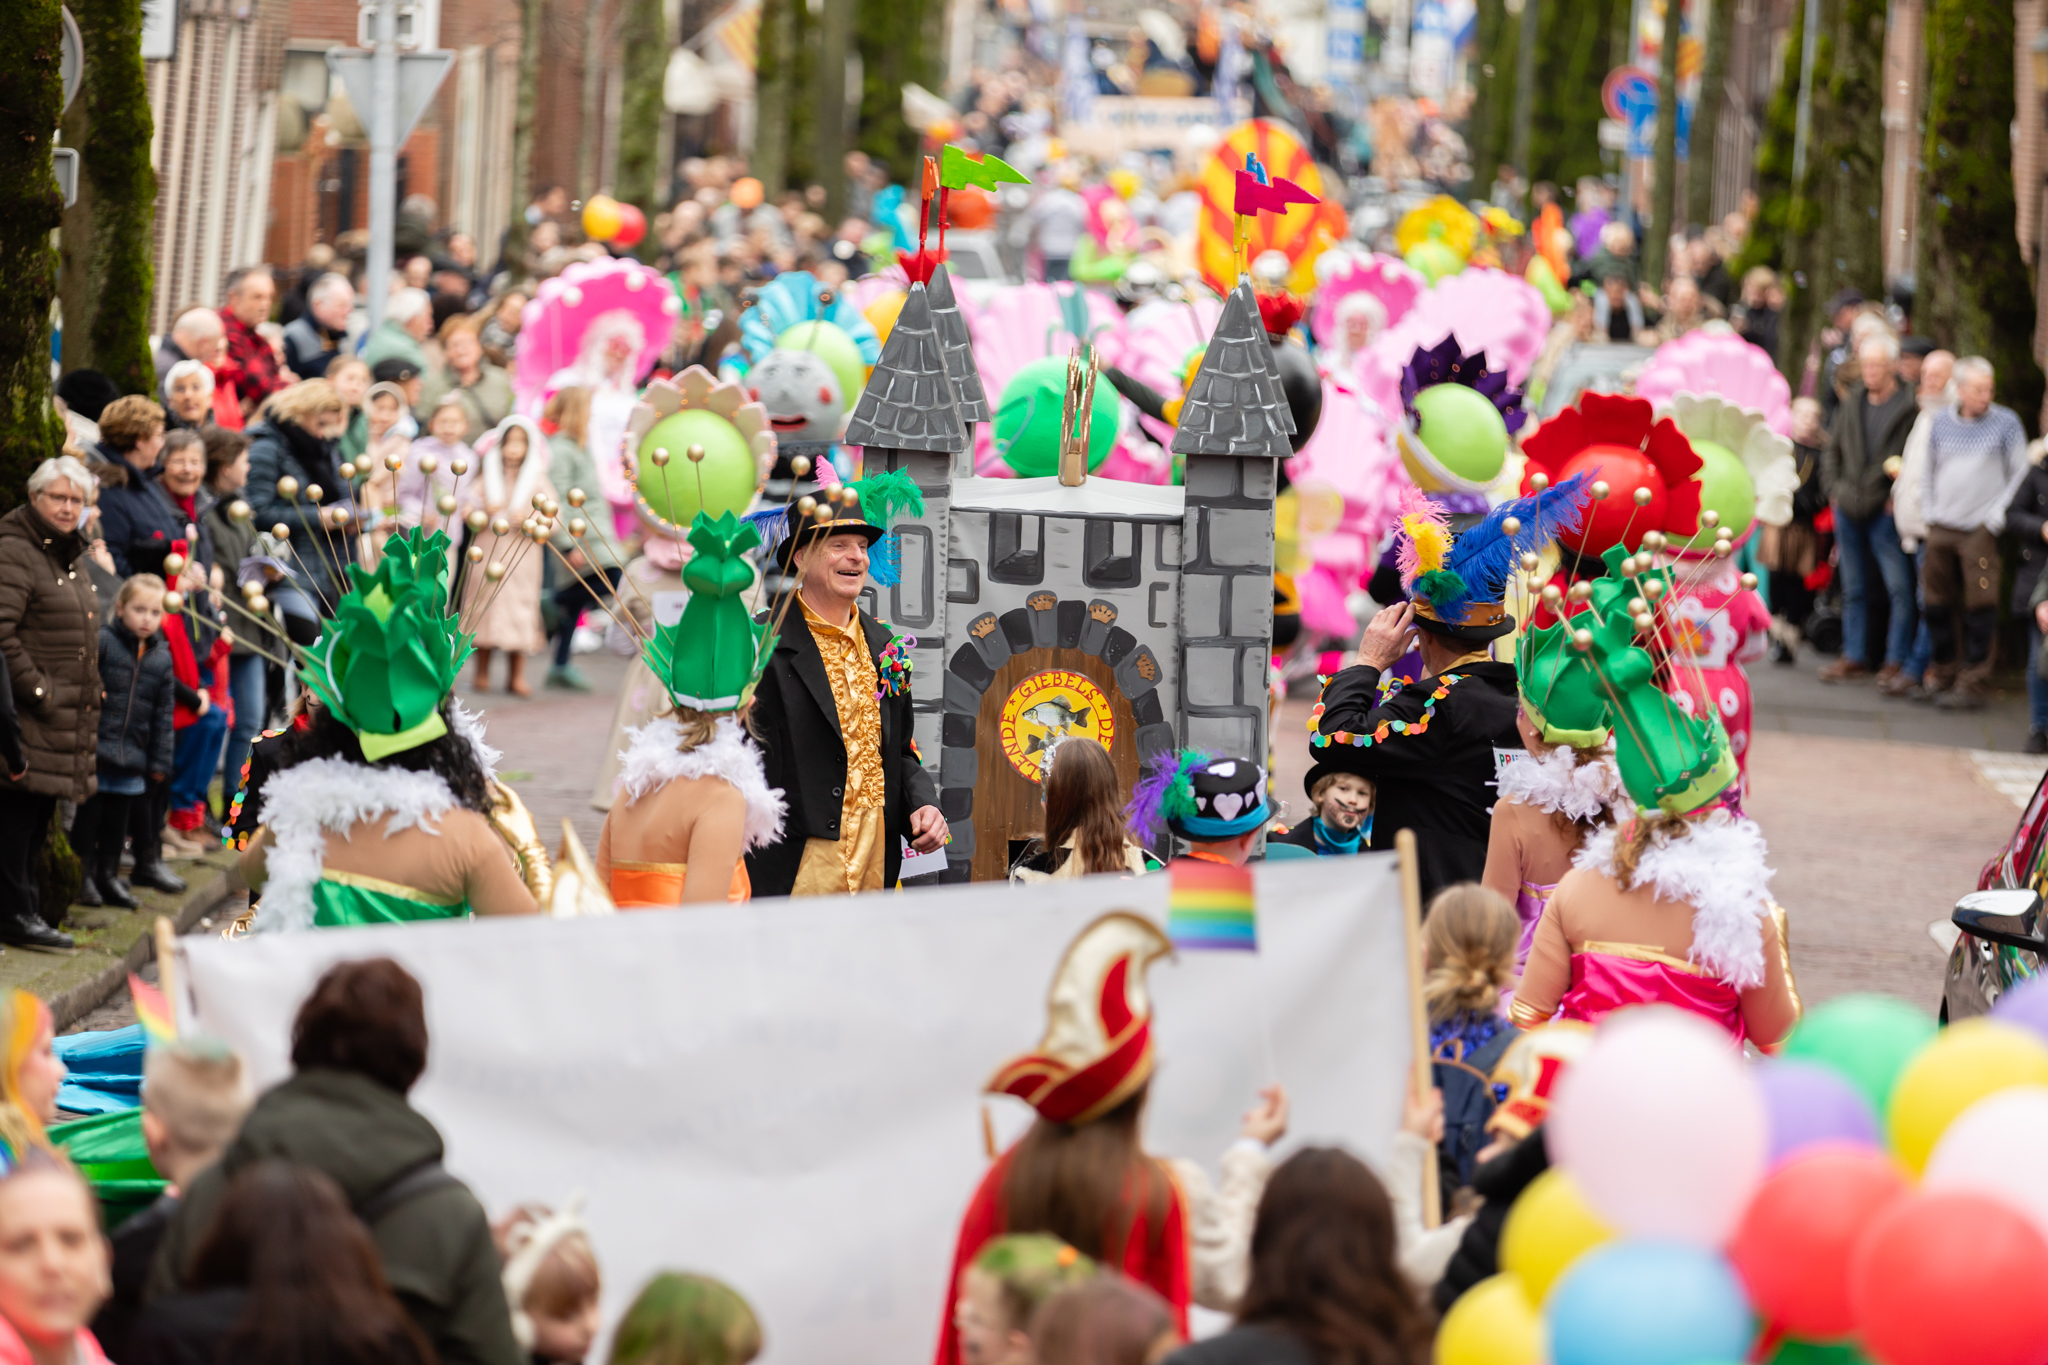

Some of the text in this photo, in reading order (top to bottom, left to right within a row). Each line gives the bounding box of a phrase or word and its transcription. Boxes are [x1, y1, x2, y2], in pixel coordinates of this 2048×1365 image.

[1002, 672, 1115, 780] GIEBELS DE LENDE
